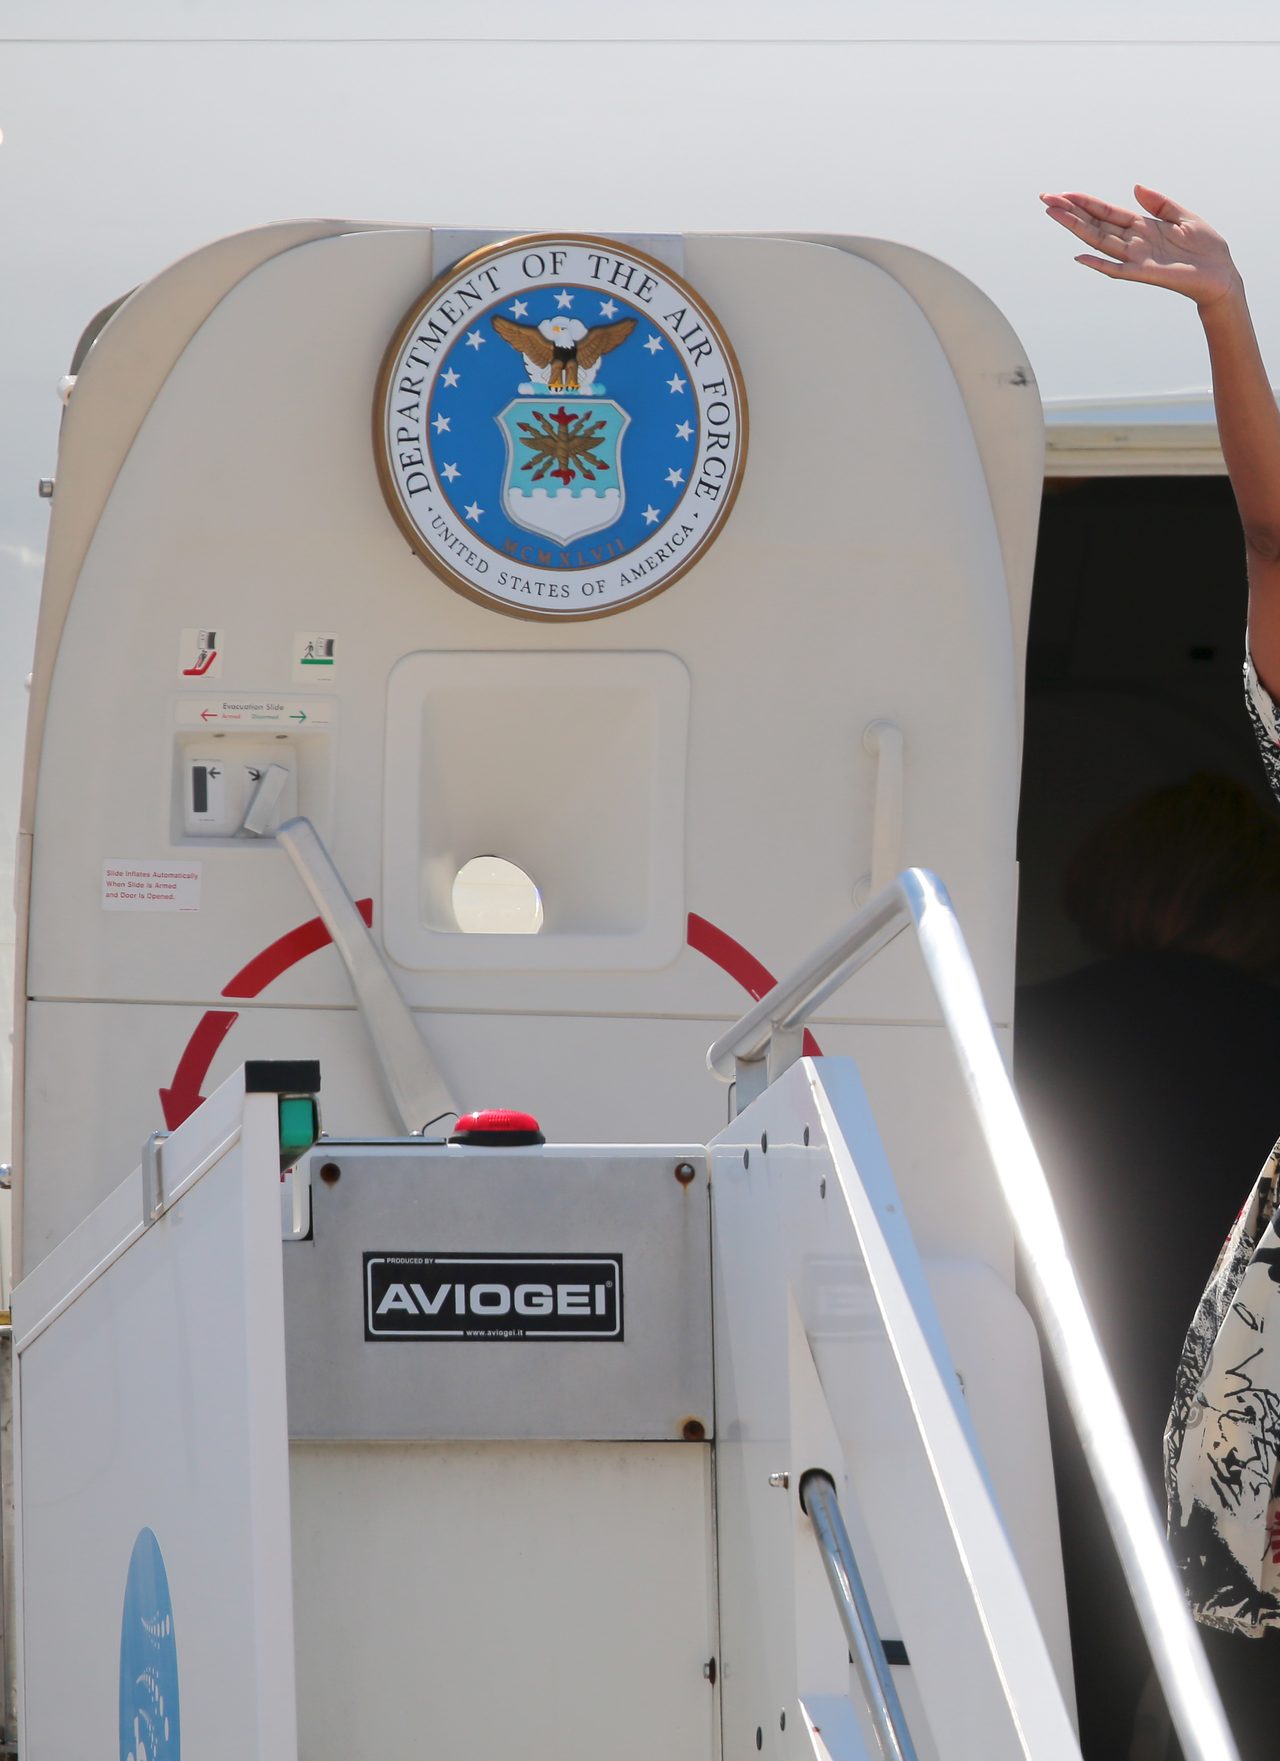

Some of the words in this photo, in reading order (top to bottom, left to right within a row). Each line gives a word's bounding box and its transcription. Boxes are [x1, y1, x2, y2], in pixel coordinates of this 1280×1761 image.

[397, 266, 502, 498] DEPARTMENT
[522, 251, 568, 279] OF
[588, 253, 659, 303] THE
[663, 307, 714, 367] AIR
[694, 377, 731, 502] FORCE
[430, 515, 490, 575] UNITED
[497, 571, 570, 598] STATES
[581, 580, 606, 596] OF
[619, 522, 694, 588] AMERICA
[503, 537, 625, 568] MCMXLVII
[222, 702, 264, 711] Evacuation
[266, 703, 285, 711] Slide
[106, 869, 123, 877] Slide
[152, 872, 198, 881] Automatically
[127, 881, 144, 889] Slide
[466, 1329, 523, 1337] www.aviogei.it
